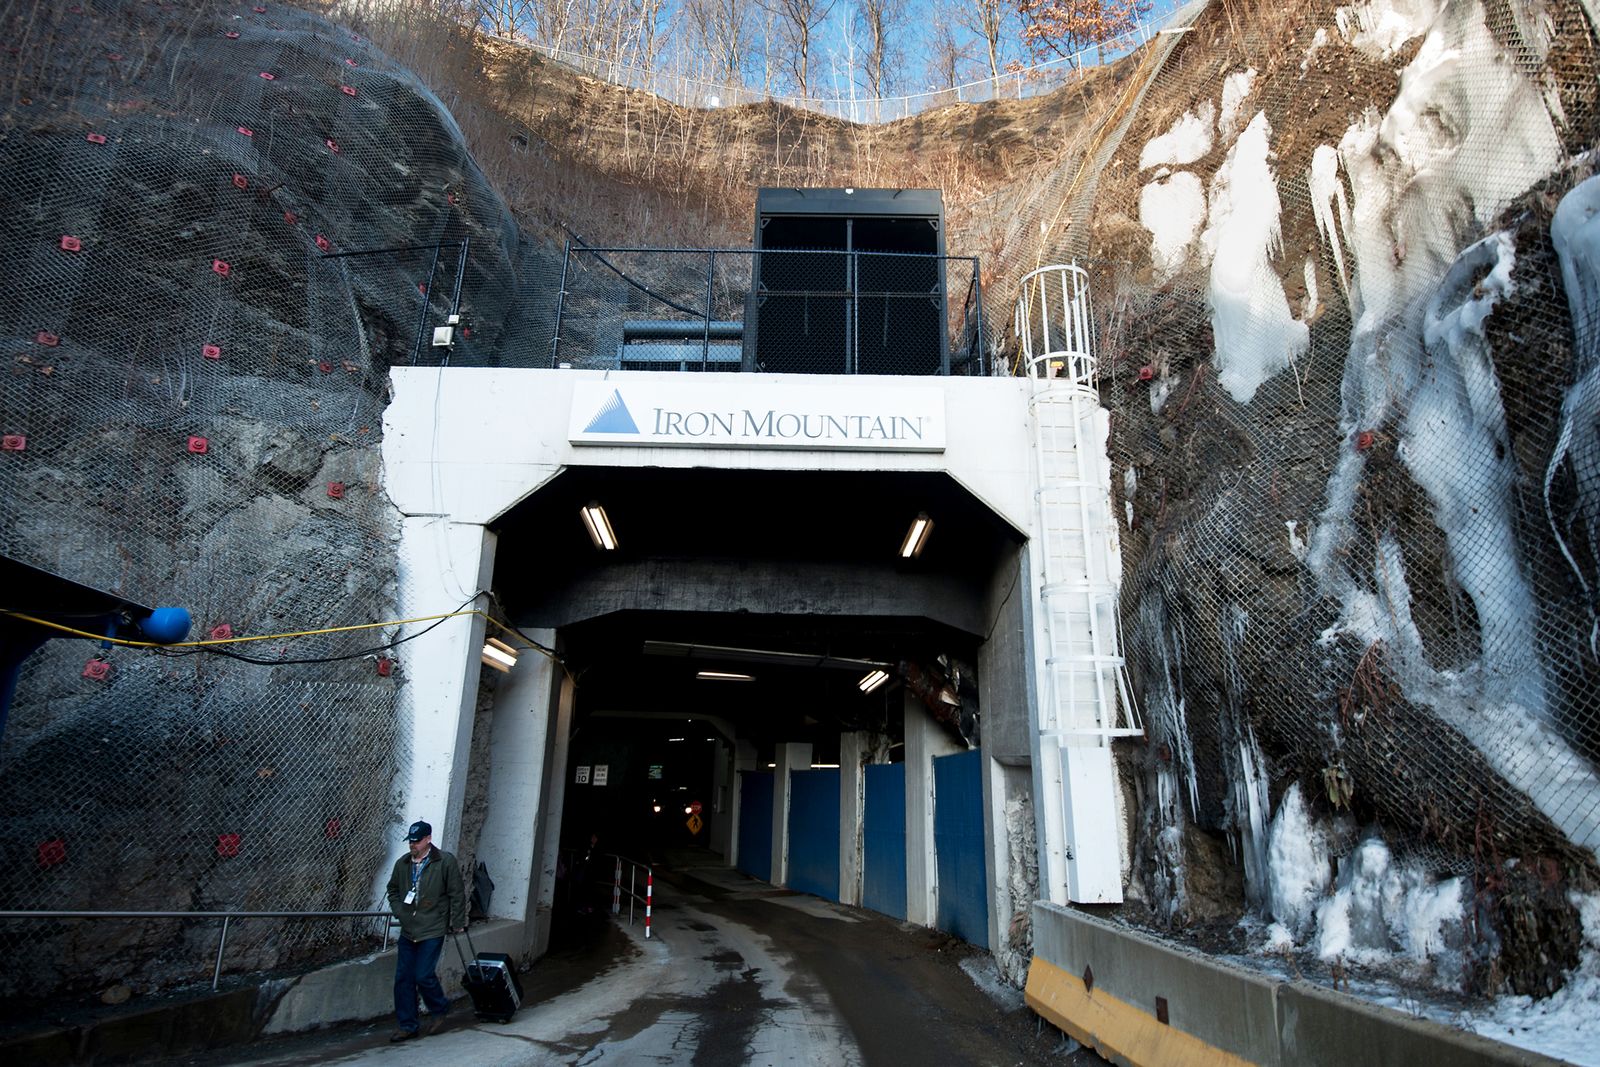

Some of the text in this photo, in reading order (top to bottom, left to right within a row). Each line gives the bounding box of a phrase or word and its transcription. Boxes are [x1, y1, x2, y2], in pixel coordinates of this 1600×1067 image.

[652, 408, 923, 440] IRON MOUNTAIN
[578, 775, 587, 783] 10
